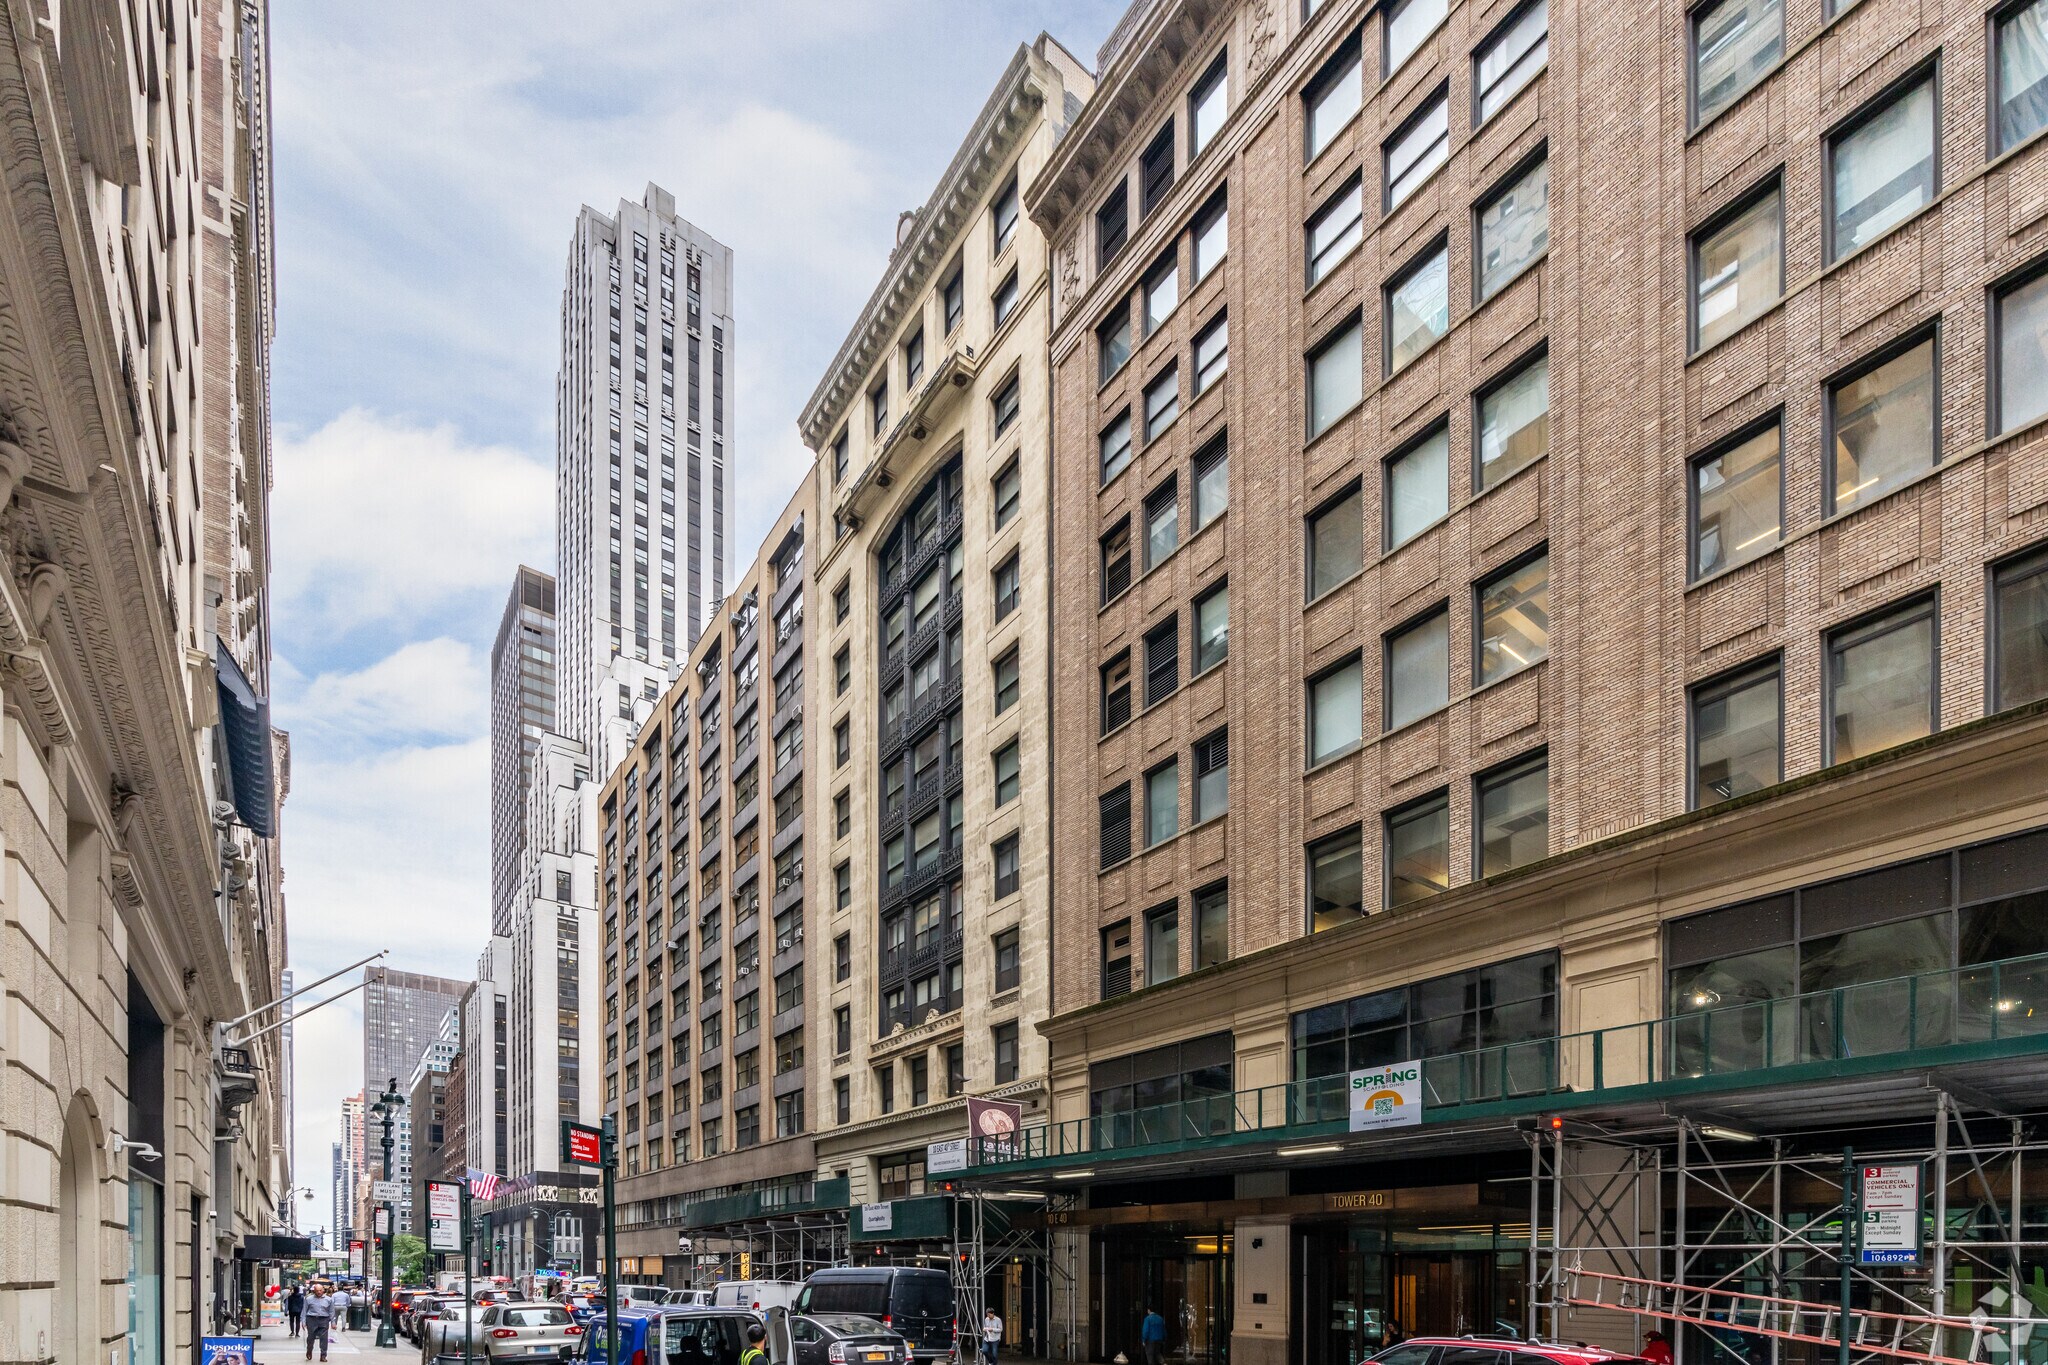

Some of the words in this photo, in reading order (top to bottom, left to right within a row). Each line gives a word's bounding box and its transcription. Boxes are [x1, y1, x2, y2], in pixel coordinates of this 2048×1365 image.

[1363, 1082, 1404, 1092] SCAFFOLDING
[577, 1131, 595, 1140] STANDING
[1869, 1168, 1878, 1177] 3
[1332, 1194, 1366, 1208] TOWER
[1368, 1193, 1383, 1206] 40
[1055, 1213, 1058, 1223] E
[1060, 1212, 1067, 1223] 40
[1868, 1212, 1876, 1222] 5
[540, 1268, 556, 1276] TACOS
[204, 1343, 250, 1352] bespoke
